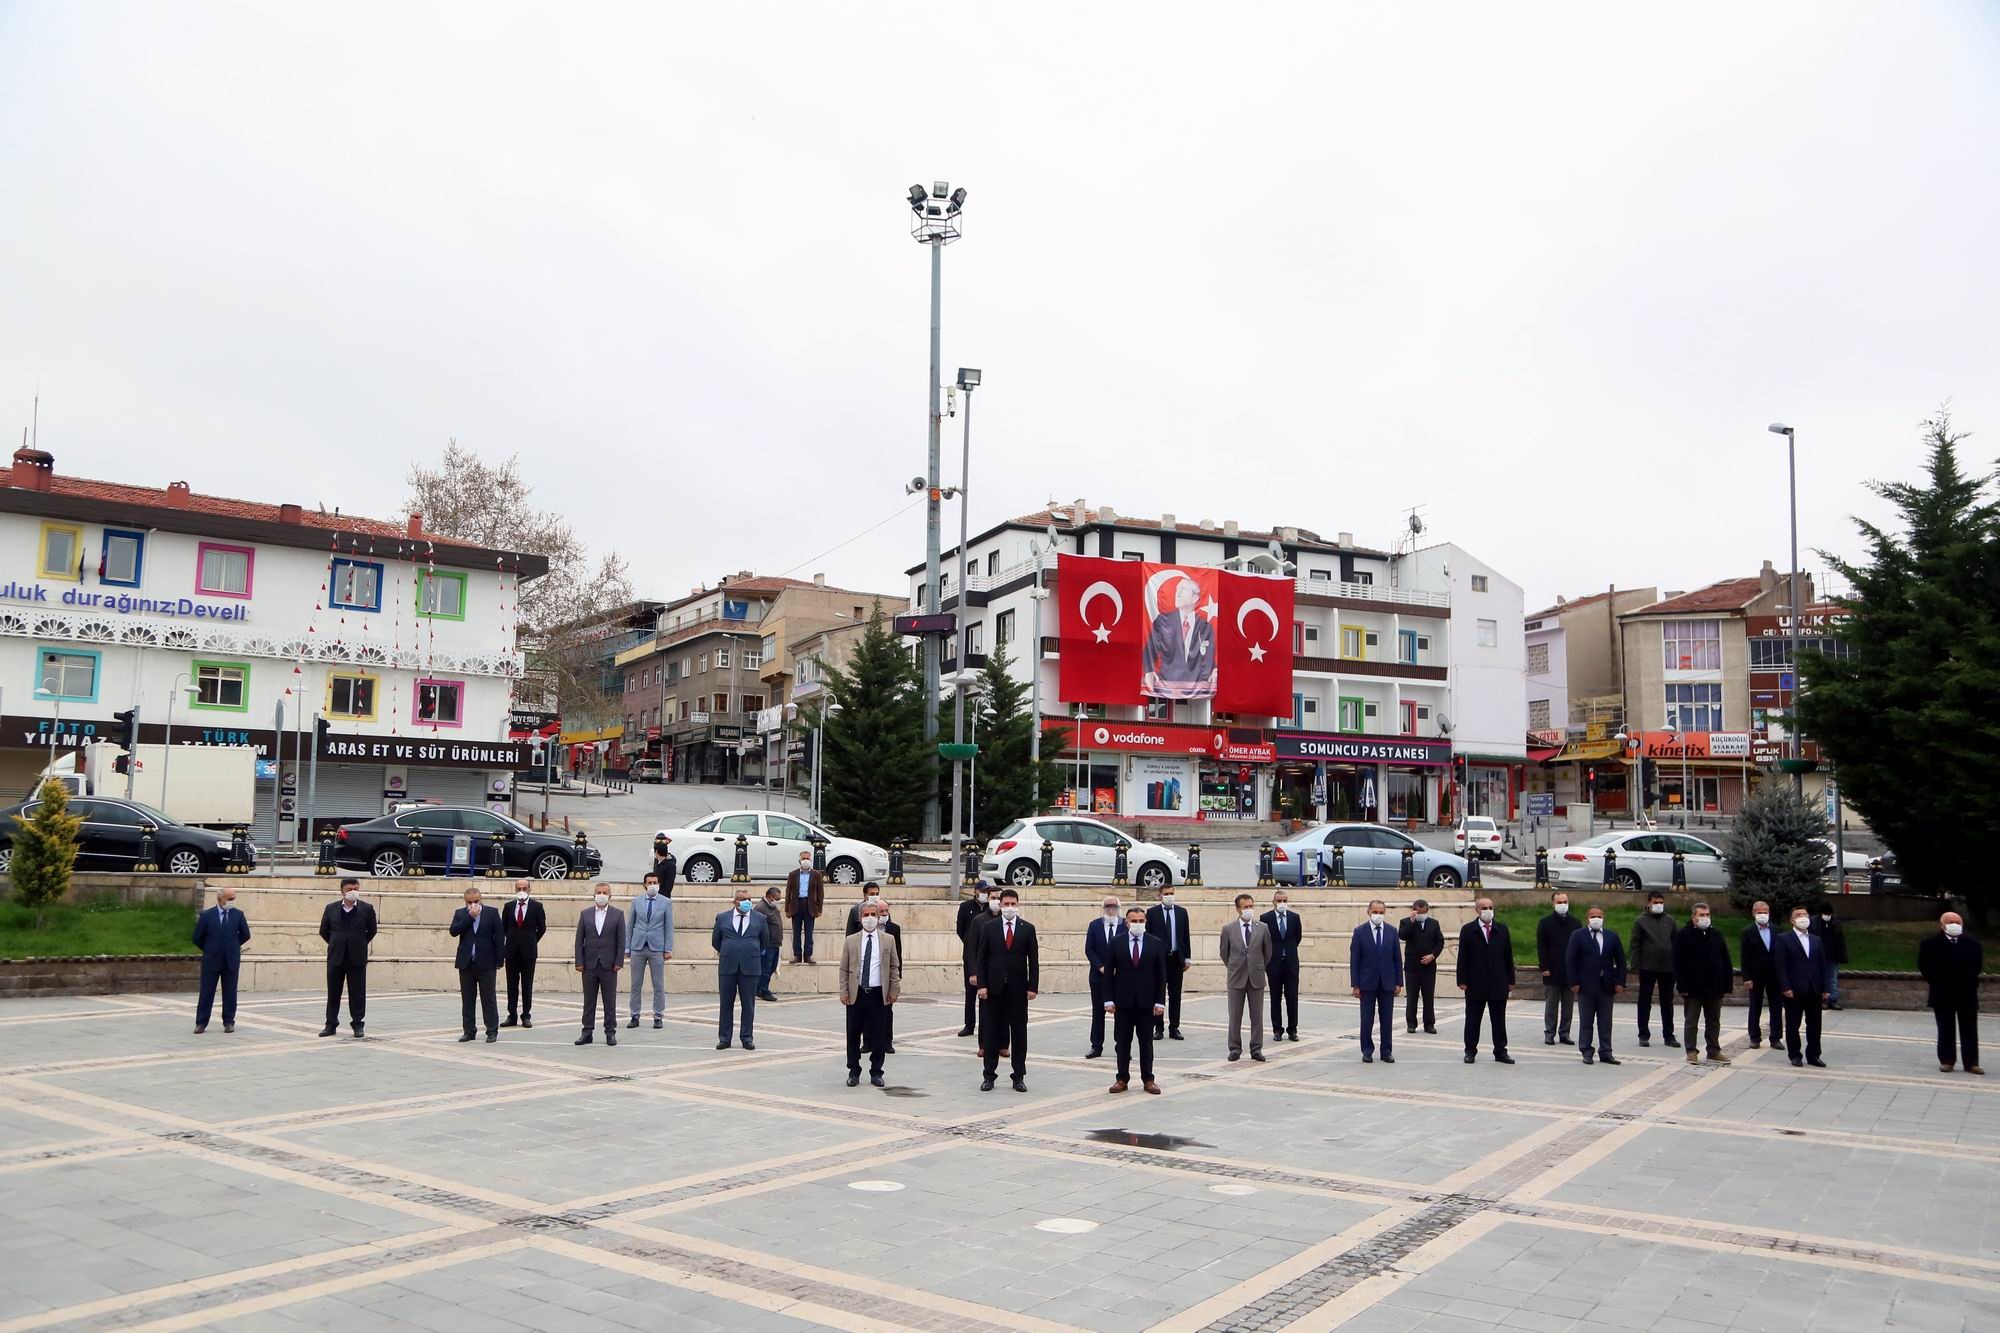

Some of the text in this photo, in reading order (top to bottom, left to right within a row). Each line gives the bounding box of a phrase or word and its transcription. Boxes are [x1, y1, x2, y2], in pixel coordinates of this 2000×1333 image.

[39, 721, 96, 735] FOTO
[24, 732, 108, 747] YILMAZ
[202, 728, 249, 743] TÜRK
[1112, 733, 1165, 745] vodafone
[328, 741, 520, 763] ARAS ET VE SÜT ÜRÜNLERİ
[1229, 745, 1271, 756] ÖMER AYBAK
[1300, 742, 1429, 760] SOMUNCU PASTANESİ
[1647, 743, 1706, 757] kinetix
[1752, 747, 1780, 755] UFUK
